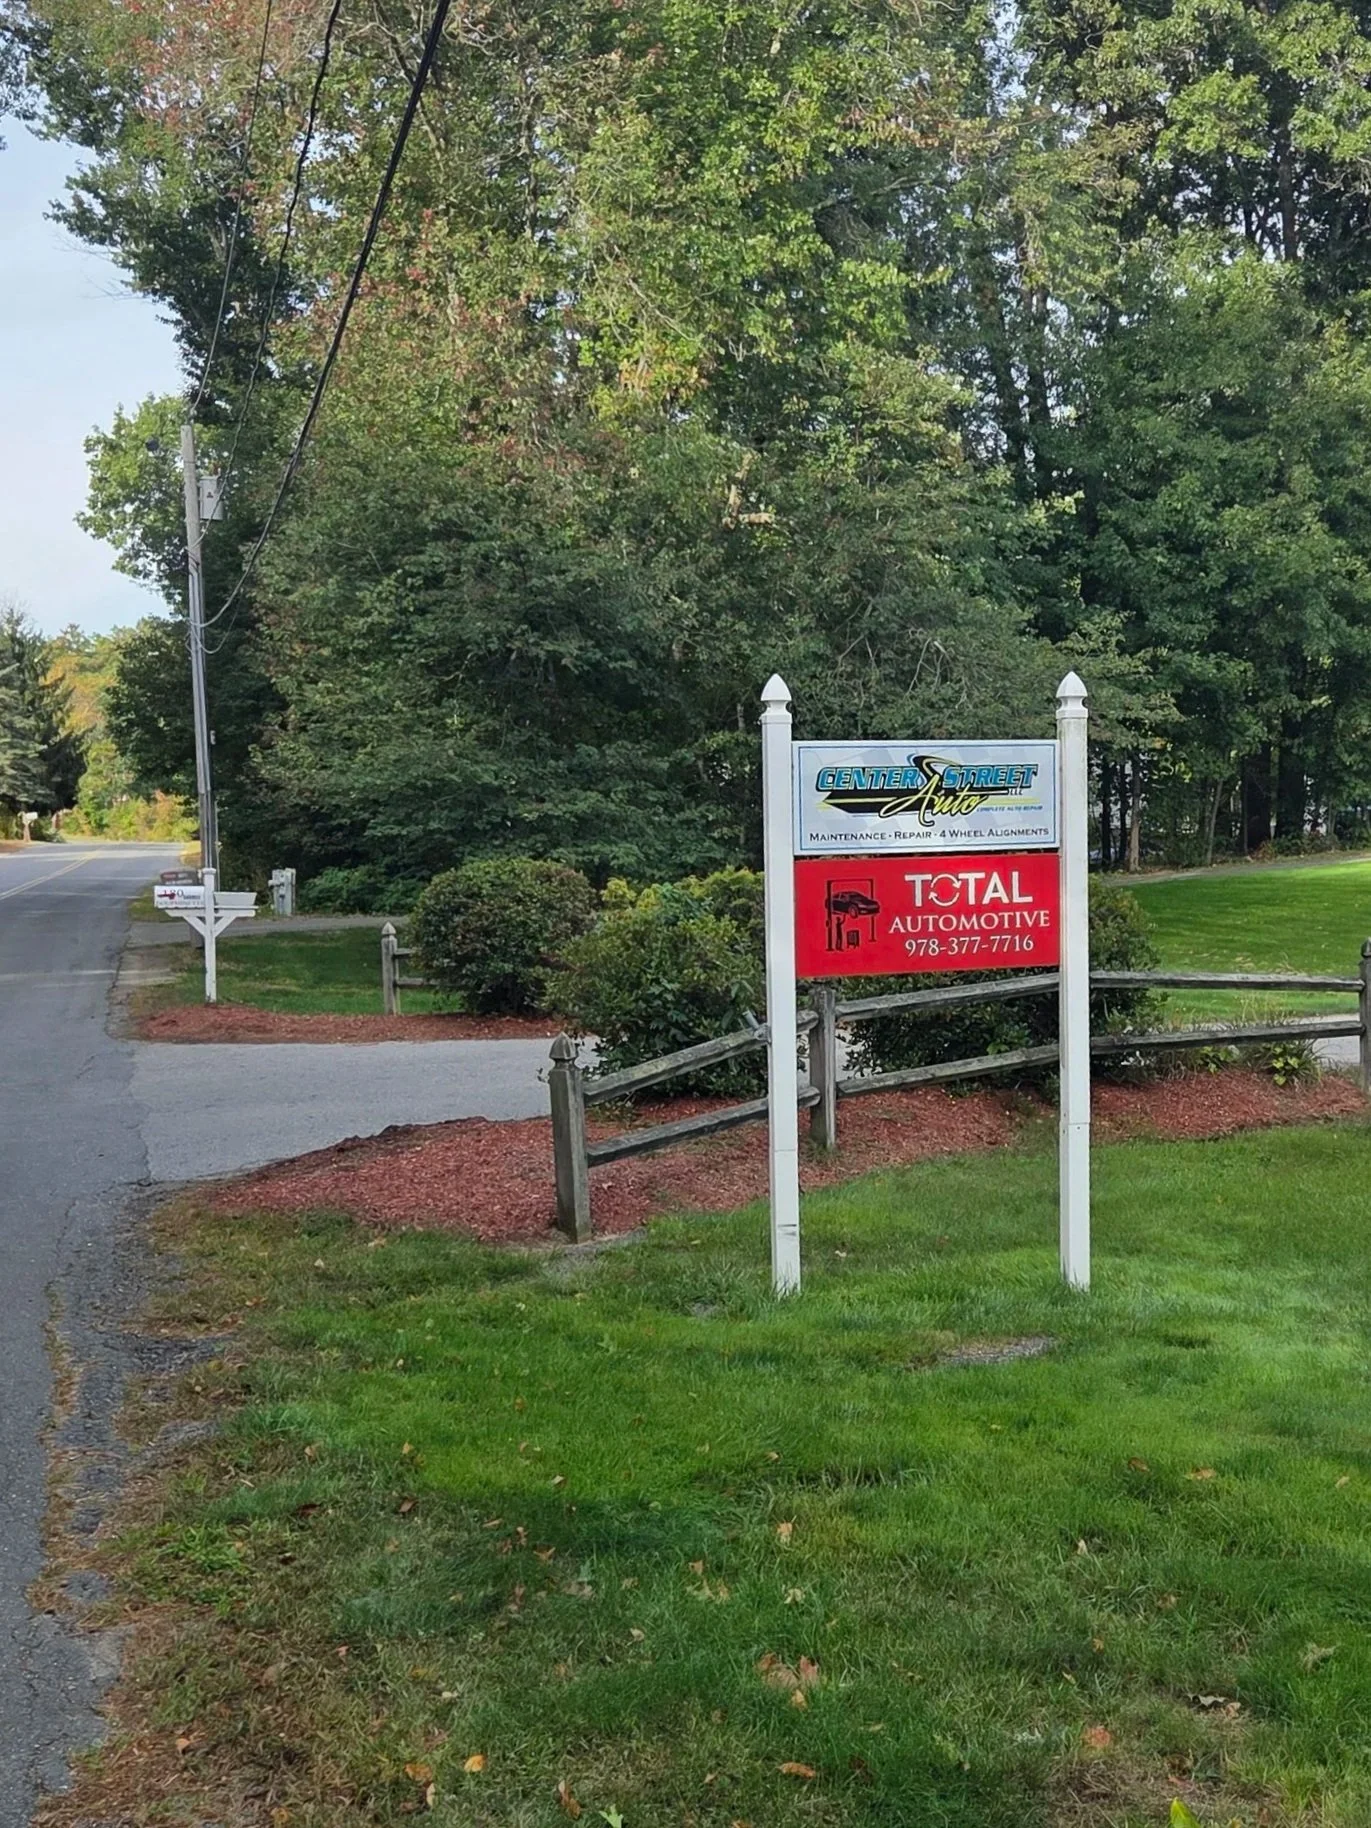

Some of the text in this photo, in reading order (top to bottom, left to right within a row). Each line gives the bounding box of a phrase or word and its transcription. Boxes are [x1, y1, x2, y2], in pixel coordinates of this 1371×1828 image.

[816, 764, 1039, 791] CENTER STREET
[878, 774, 990, 827] Auto
[809, 827, 1050, 842] MAINTENANCE REPAIR 4 WHEEL ALIGNMENTS
[904, 871, 1033, 907] TOTAL
[888, 910, 1050, 934] AUTOMOTIVE
[905, 934, 1034, 957] 978-377-7716
